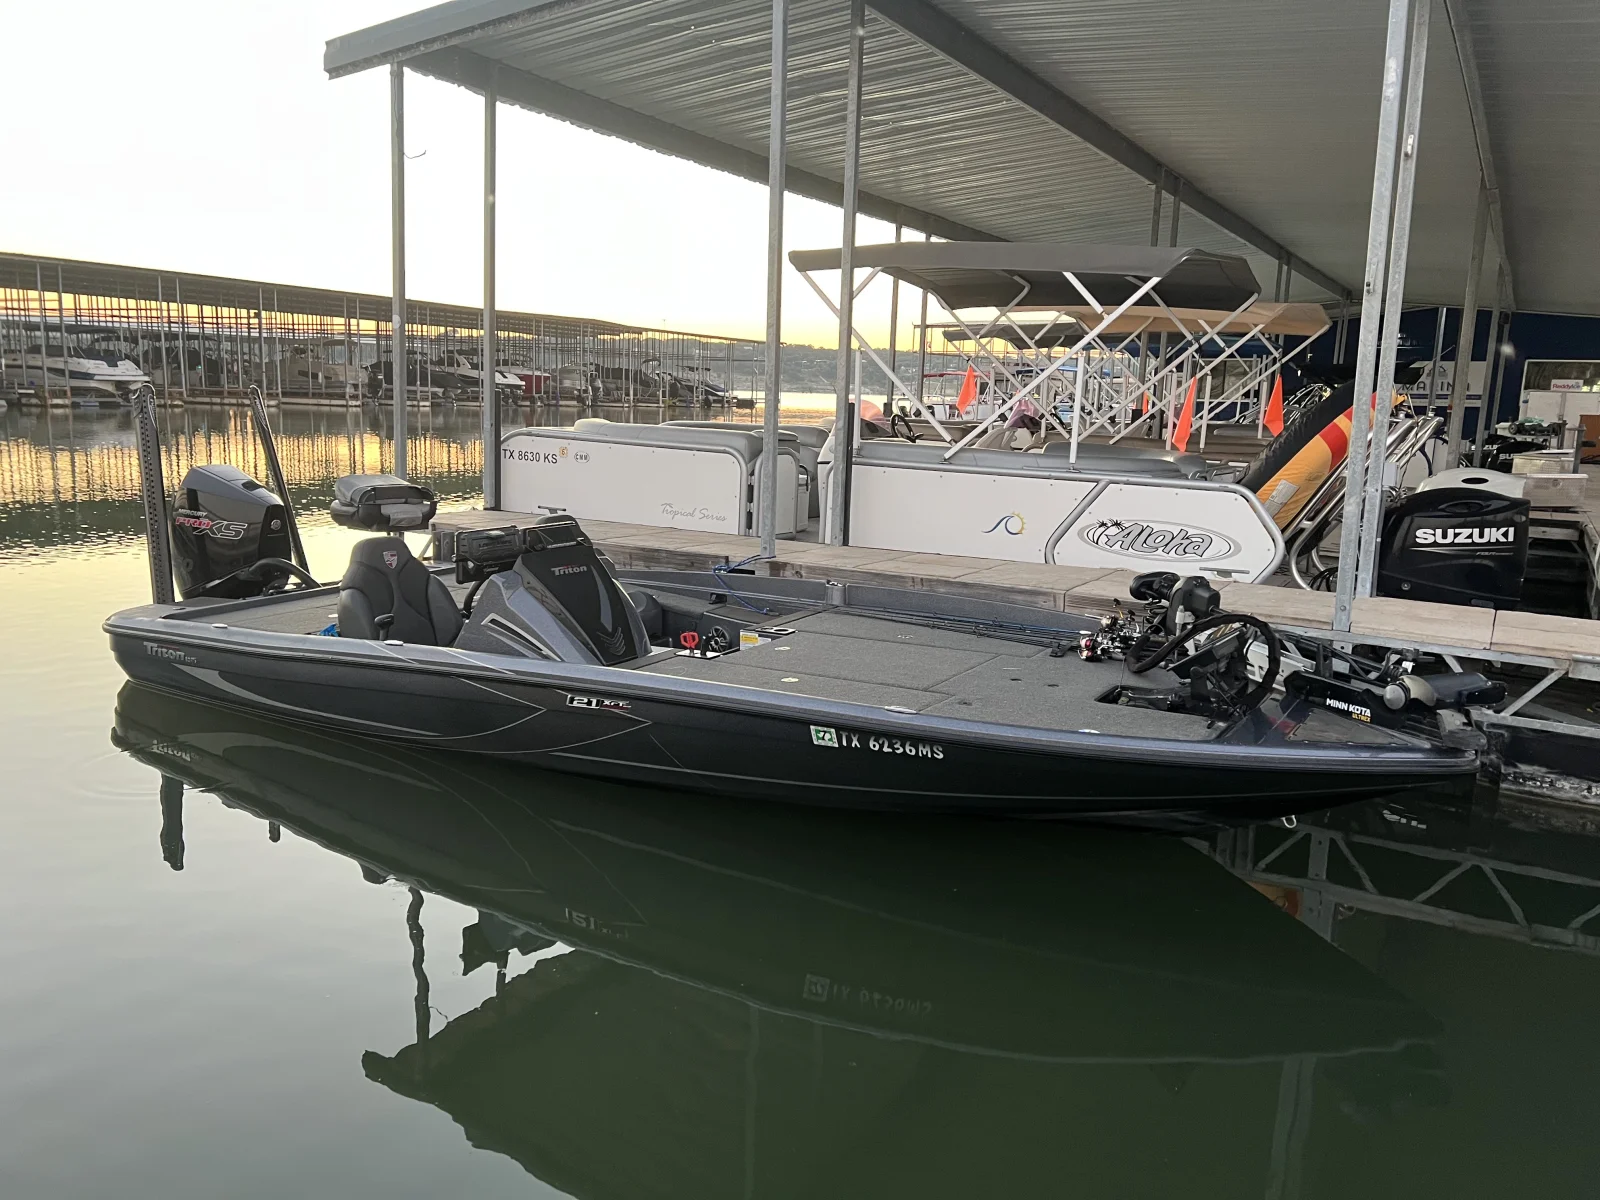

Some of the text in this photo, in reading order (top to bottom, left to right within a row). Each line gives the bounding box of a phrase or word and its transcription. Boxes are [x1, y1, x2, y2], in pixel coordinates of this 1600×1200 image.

[502, 448, 558, 464] TX 8630 KS
[178, 508, 208, 518] MERCURY
[661, 502, 728, 522] Tropical Series
[175, 517, 248, 540] PRO XS
[1415, 526, 1515, 544] SUZUKI
[573, 696, 597, 708] 21
[1326, 698, 1371, 717] MINN KOTA
[840, 731, 944, 760] TX 6236MS
